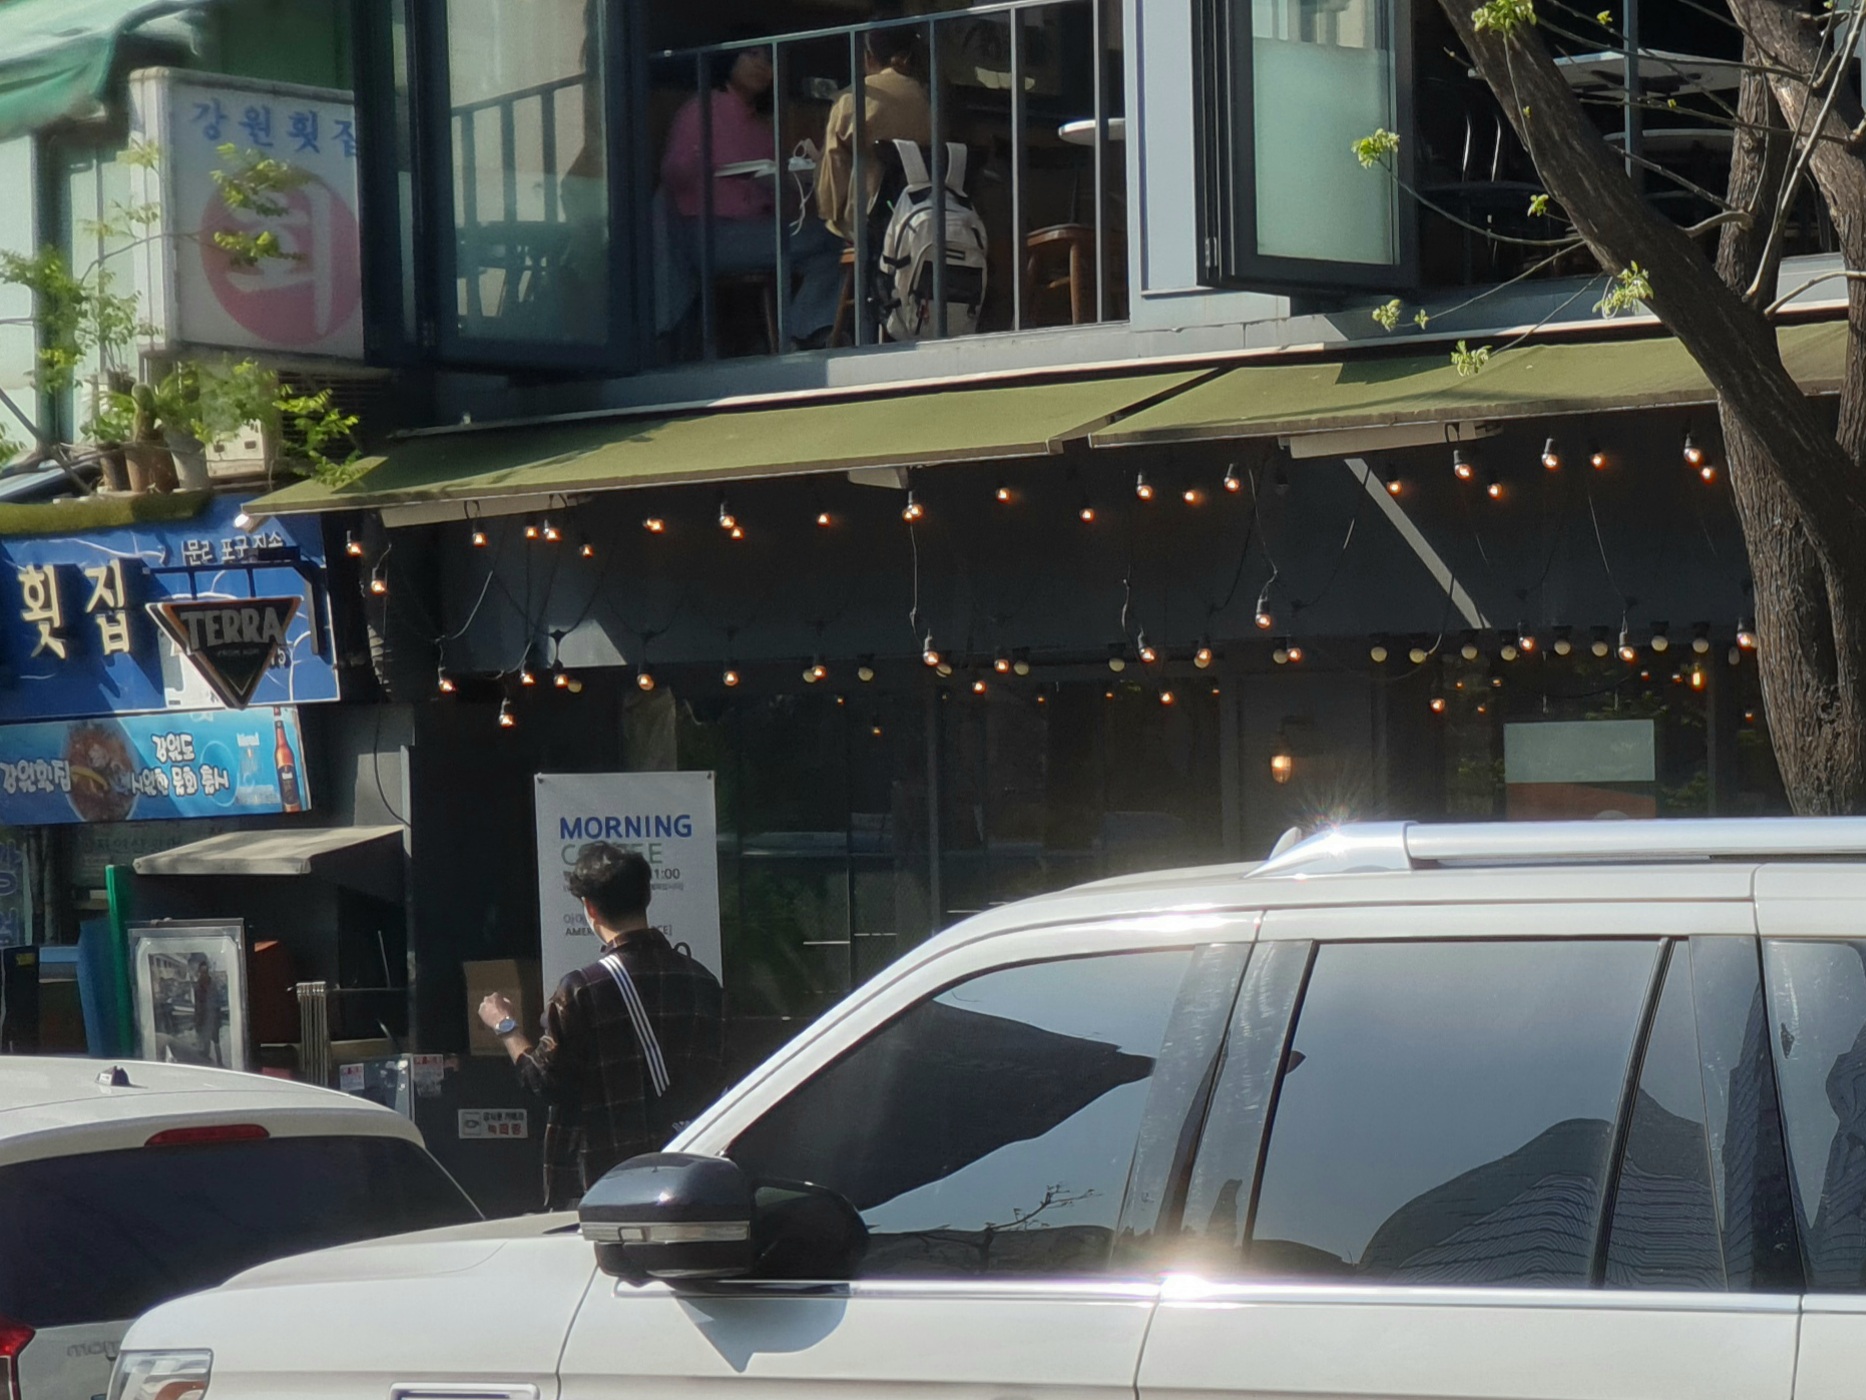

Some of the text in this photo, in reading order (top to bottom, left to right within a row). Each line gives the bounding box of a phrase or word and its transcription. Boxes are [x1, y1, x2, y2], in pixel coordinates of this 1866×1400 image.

[220, 535, 249, 560] 포구
[18, 558, 129, 659] 횟집
[179, 606, 286, 650] TERRA
[152, 733, 195, 762] 강원도
[0, 758, 72, 794] 강원횟집
[560, 814, 692, 839] MORNING
